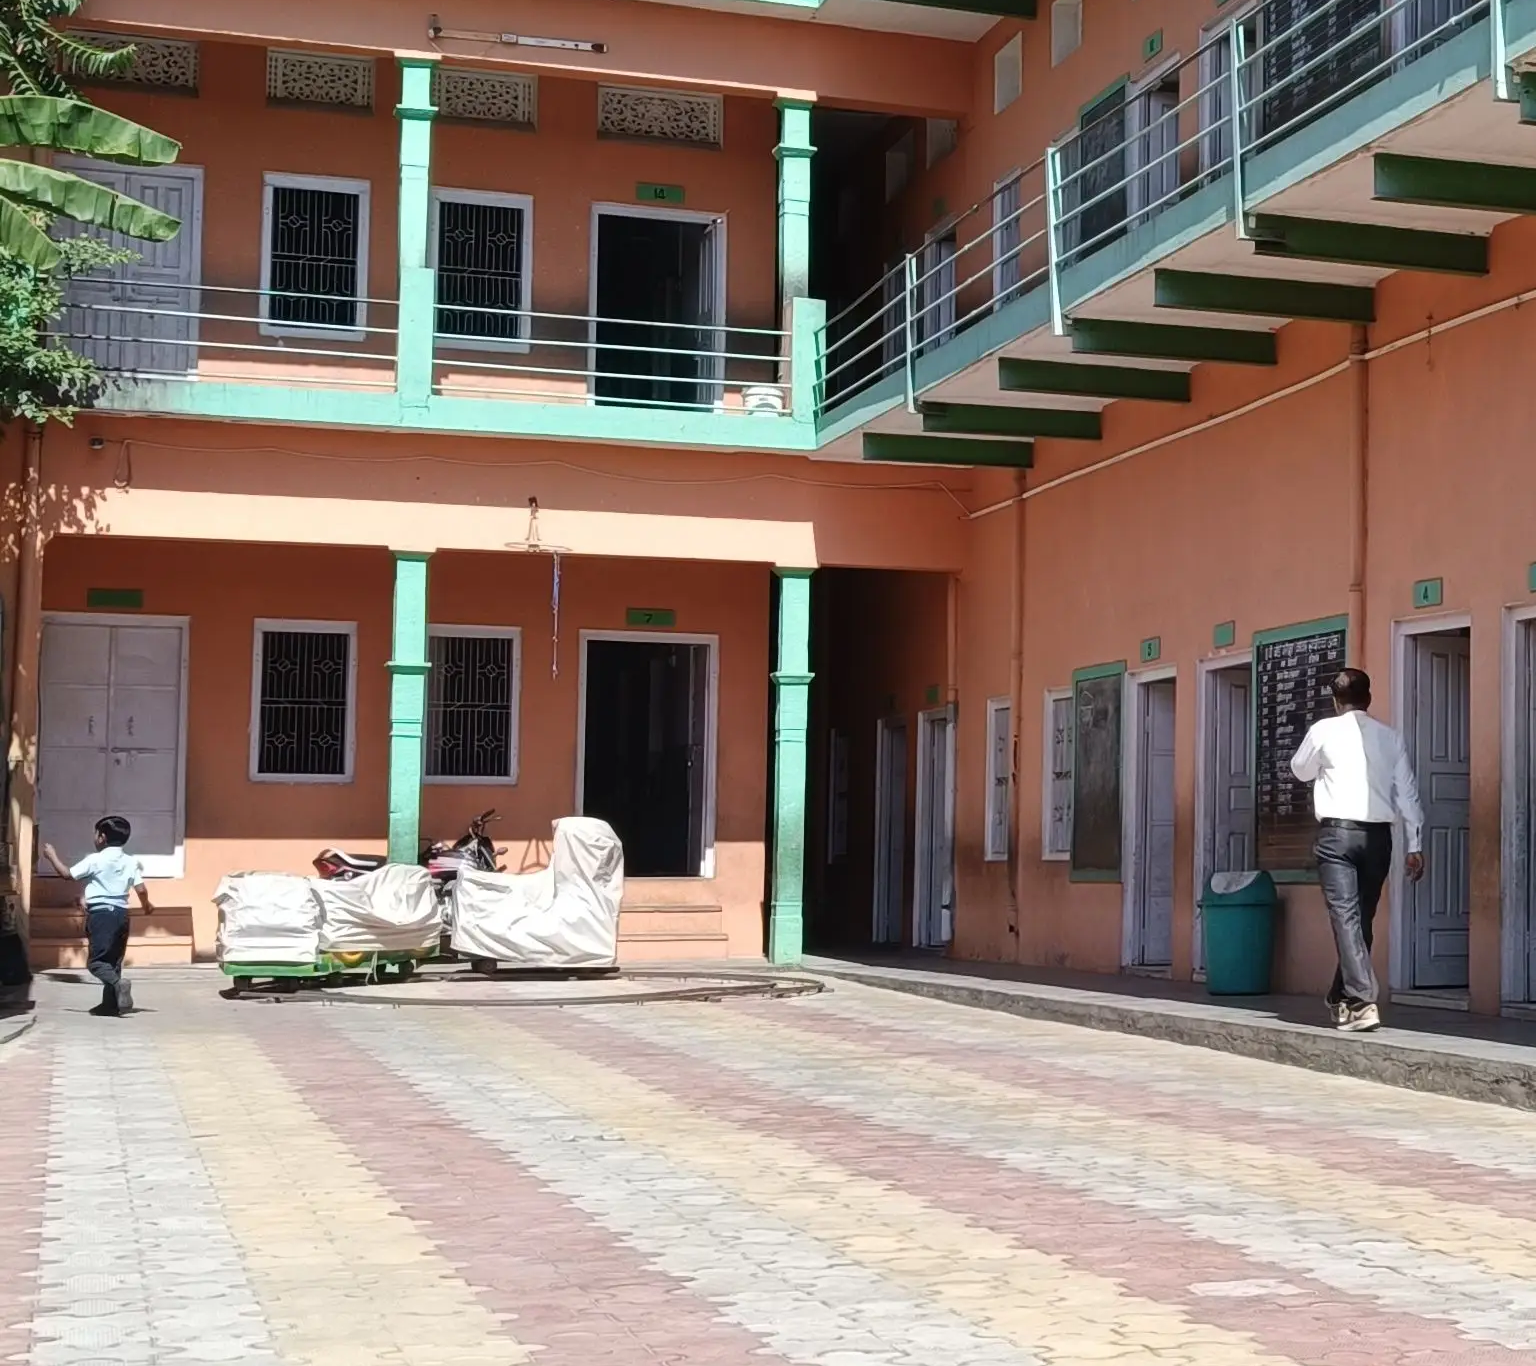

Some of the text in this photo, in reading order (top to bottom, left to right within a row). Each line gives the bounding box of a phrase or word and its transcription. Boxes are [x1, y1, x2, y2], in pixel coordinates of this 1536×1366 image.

[1422, 585, 1429, 603] 4
[643, 613, 653, 624] 7
[1147, 642, 1153, 657] 5
